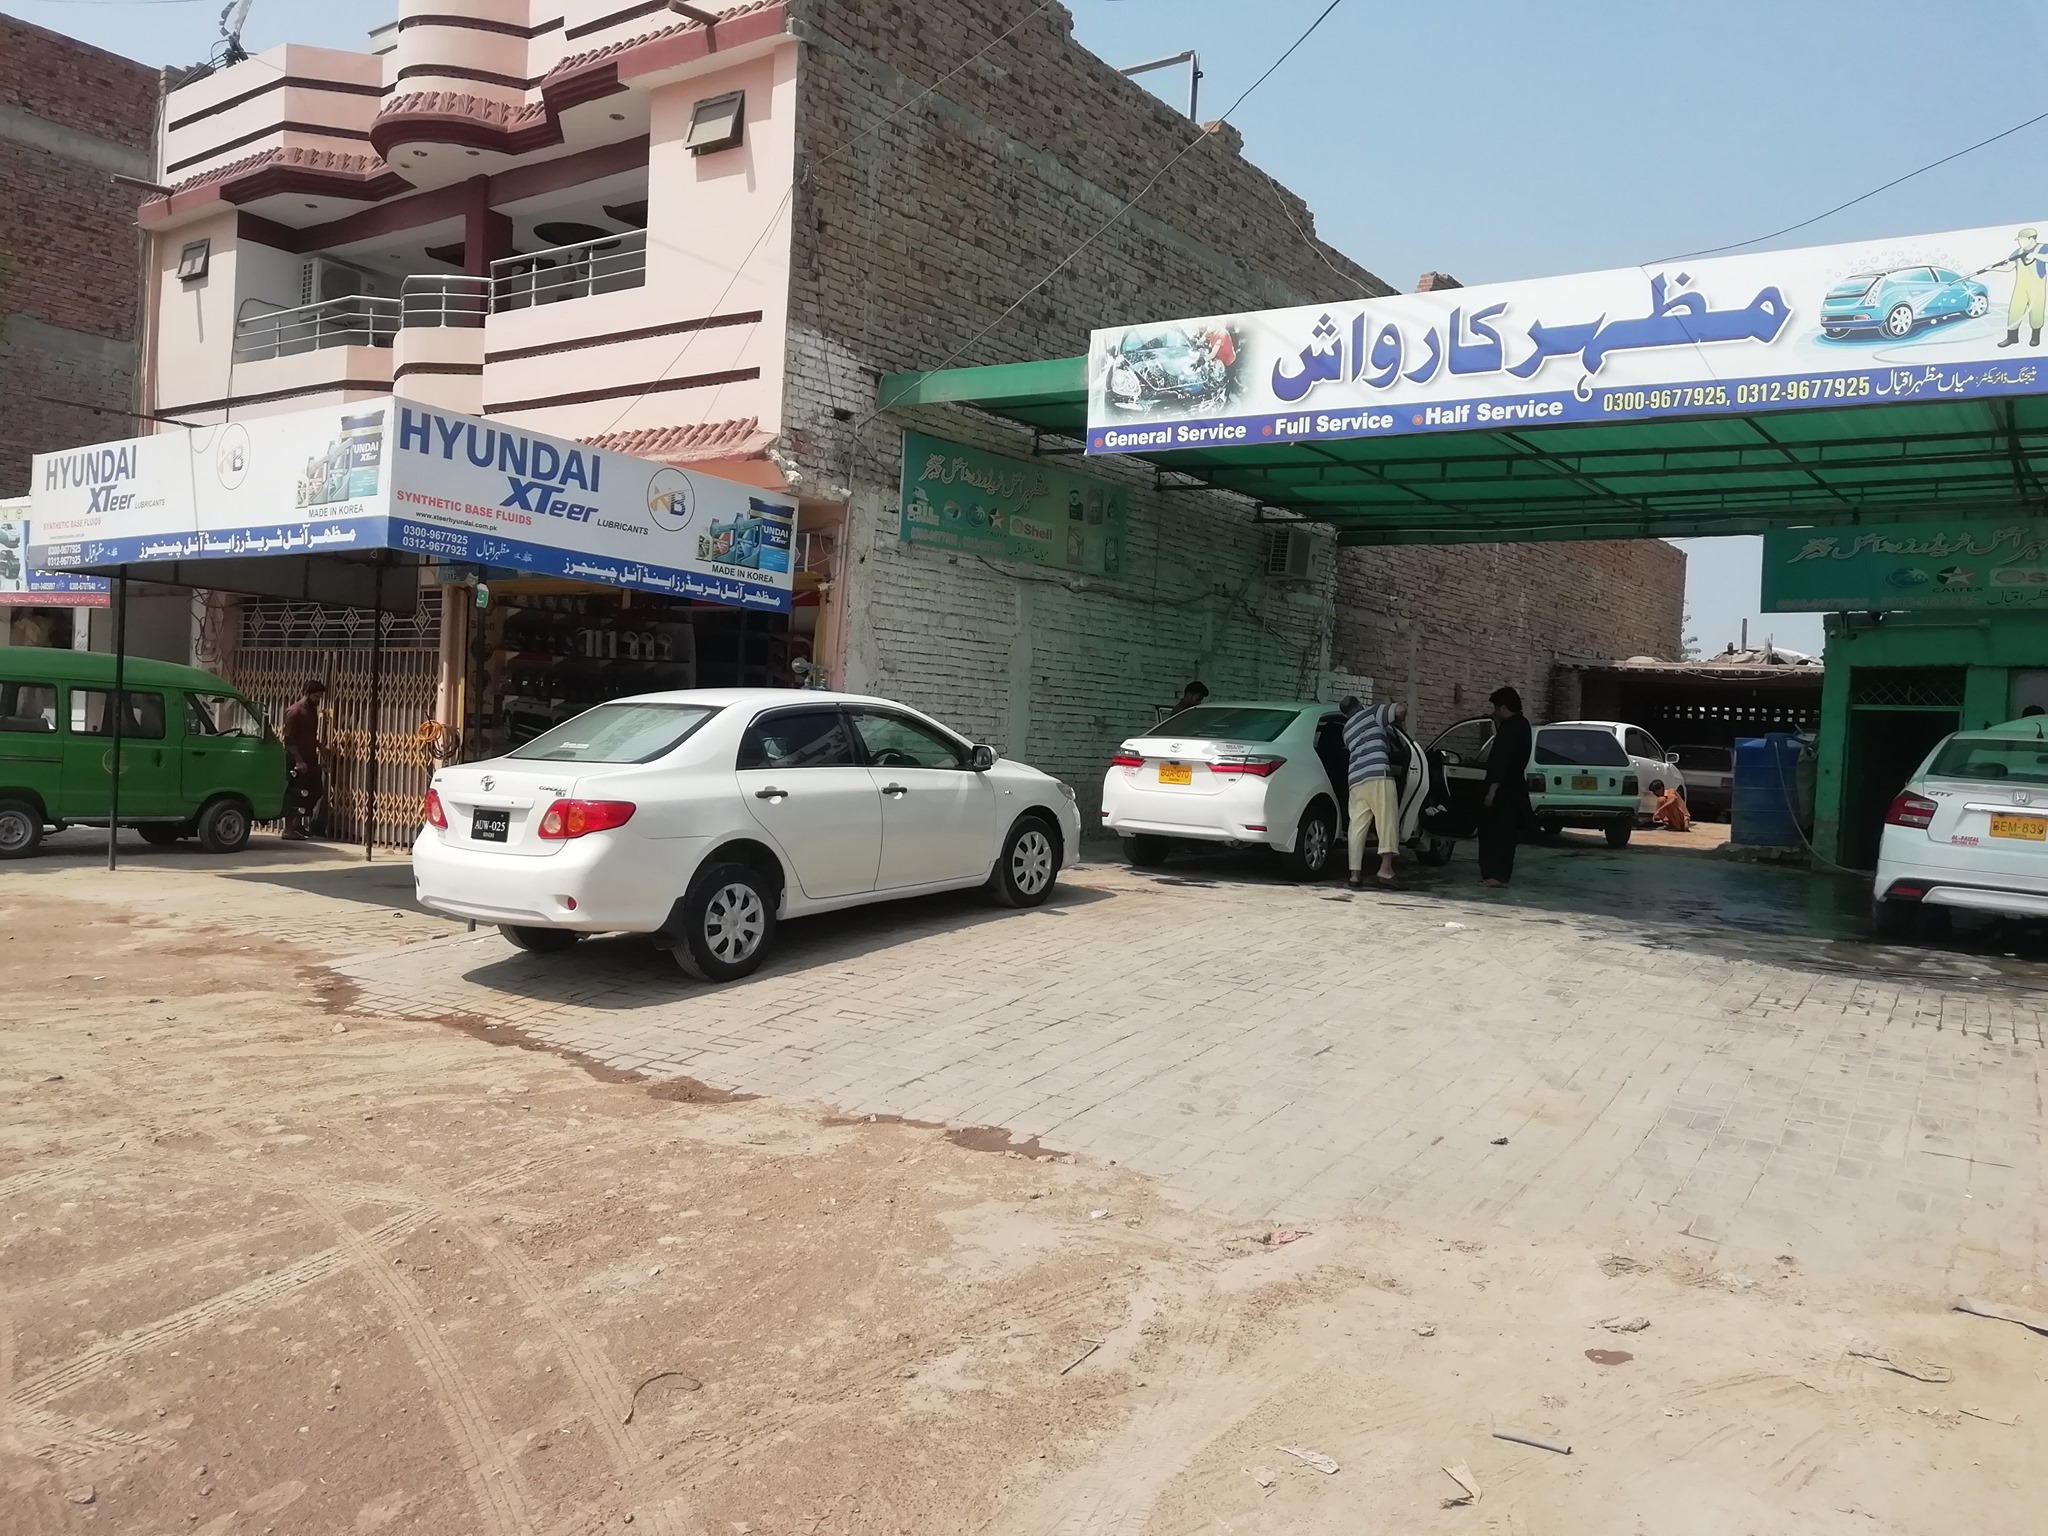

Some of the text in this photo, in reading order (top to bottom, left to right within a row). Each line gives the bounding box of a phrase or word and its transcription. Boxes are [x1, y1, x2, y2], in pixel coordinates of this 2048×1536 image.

[1271, 269, 1794, 402] مظہر کار واش
[1876, 369, 1912, 396] اقبال
[1905, 366, 1943, 396] مظہر
[1603, 376, 1870, 412] 0300-9677925, 0312-9677925
[1275, 412, 1394, 436] Full Service
[1425, 399, 1563, 425] Half Service
[1105, 423, 1246, 447] General Service
[400, 407, 600, 492] HYUNDAI
[46, 445, 136, 491] HYUNDAI
[86, 484, 166, 514] XTeer LUBRICANTS
[308, 504, 364, 518] MADE IN KOREA
[397, 490, 532, 526] SYNTHETIC BASE FLUIDS
[499, 476, 649, 536] XTeer LUBRICANTS
[43, 521, 69, 531] SYNTHETIC
[70, 519, 83, 529] BASE
[416, 511, 497, 531] www.xteerhyundai.com.pk
[1024, 523, 1053, 540] Shell
[402, 537, 467, 556] 0312-9677925
[403, 525, 468, 545] 0300-9677925
[712, 564, 774, 584] MADE IN KOREA
[474, 820, 506, 831] AUW-025
[1993, 820, 2044, 835] BEM-839
